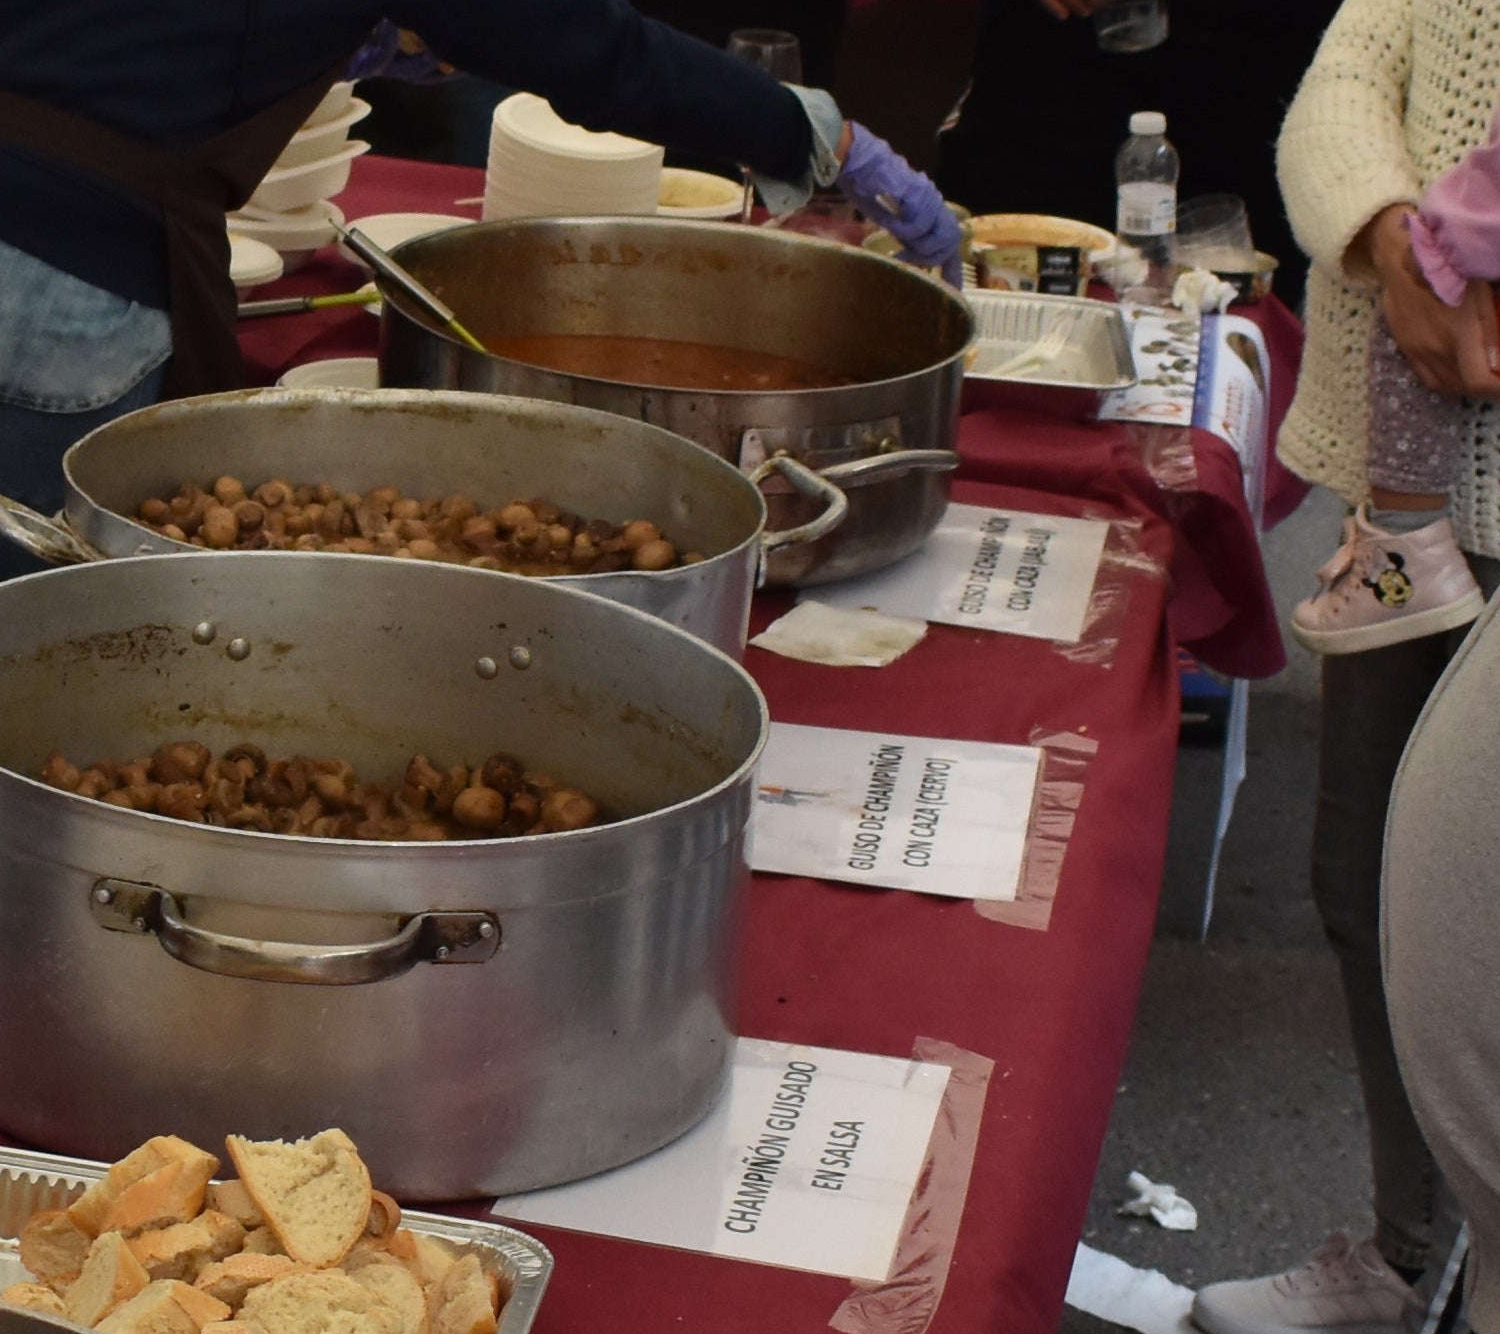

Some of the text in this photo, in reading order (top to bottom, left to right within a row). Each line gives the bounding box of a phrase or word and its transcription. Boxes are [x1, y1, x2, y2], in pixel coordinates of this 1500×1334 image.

[958, 516, 1012, 614] GUISO DE CHAMPÑÓN
[1006, 590, 1034, 611] CON
[1014, 566, 1042, 588] CAZA
[848, 744, 905, 870] GUISO DE CHAMPIÑÓN
[902, 757, 959, 868] CON CAZA (CIERVO)
[724, 1060, 818, 1234] CHAMPIÑÓN GUISADO
[811, 1121, 866, 1191] EN SALSA
